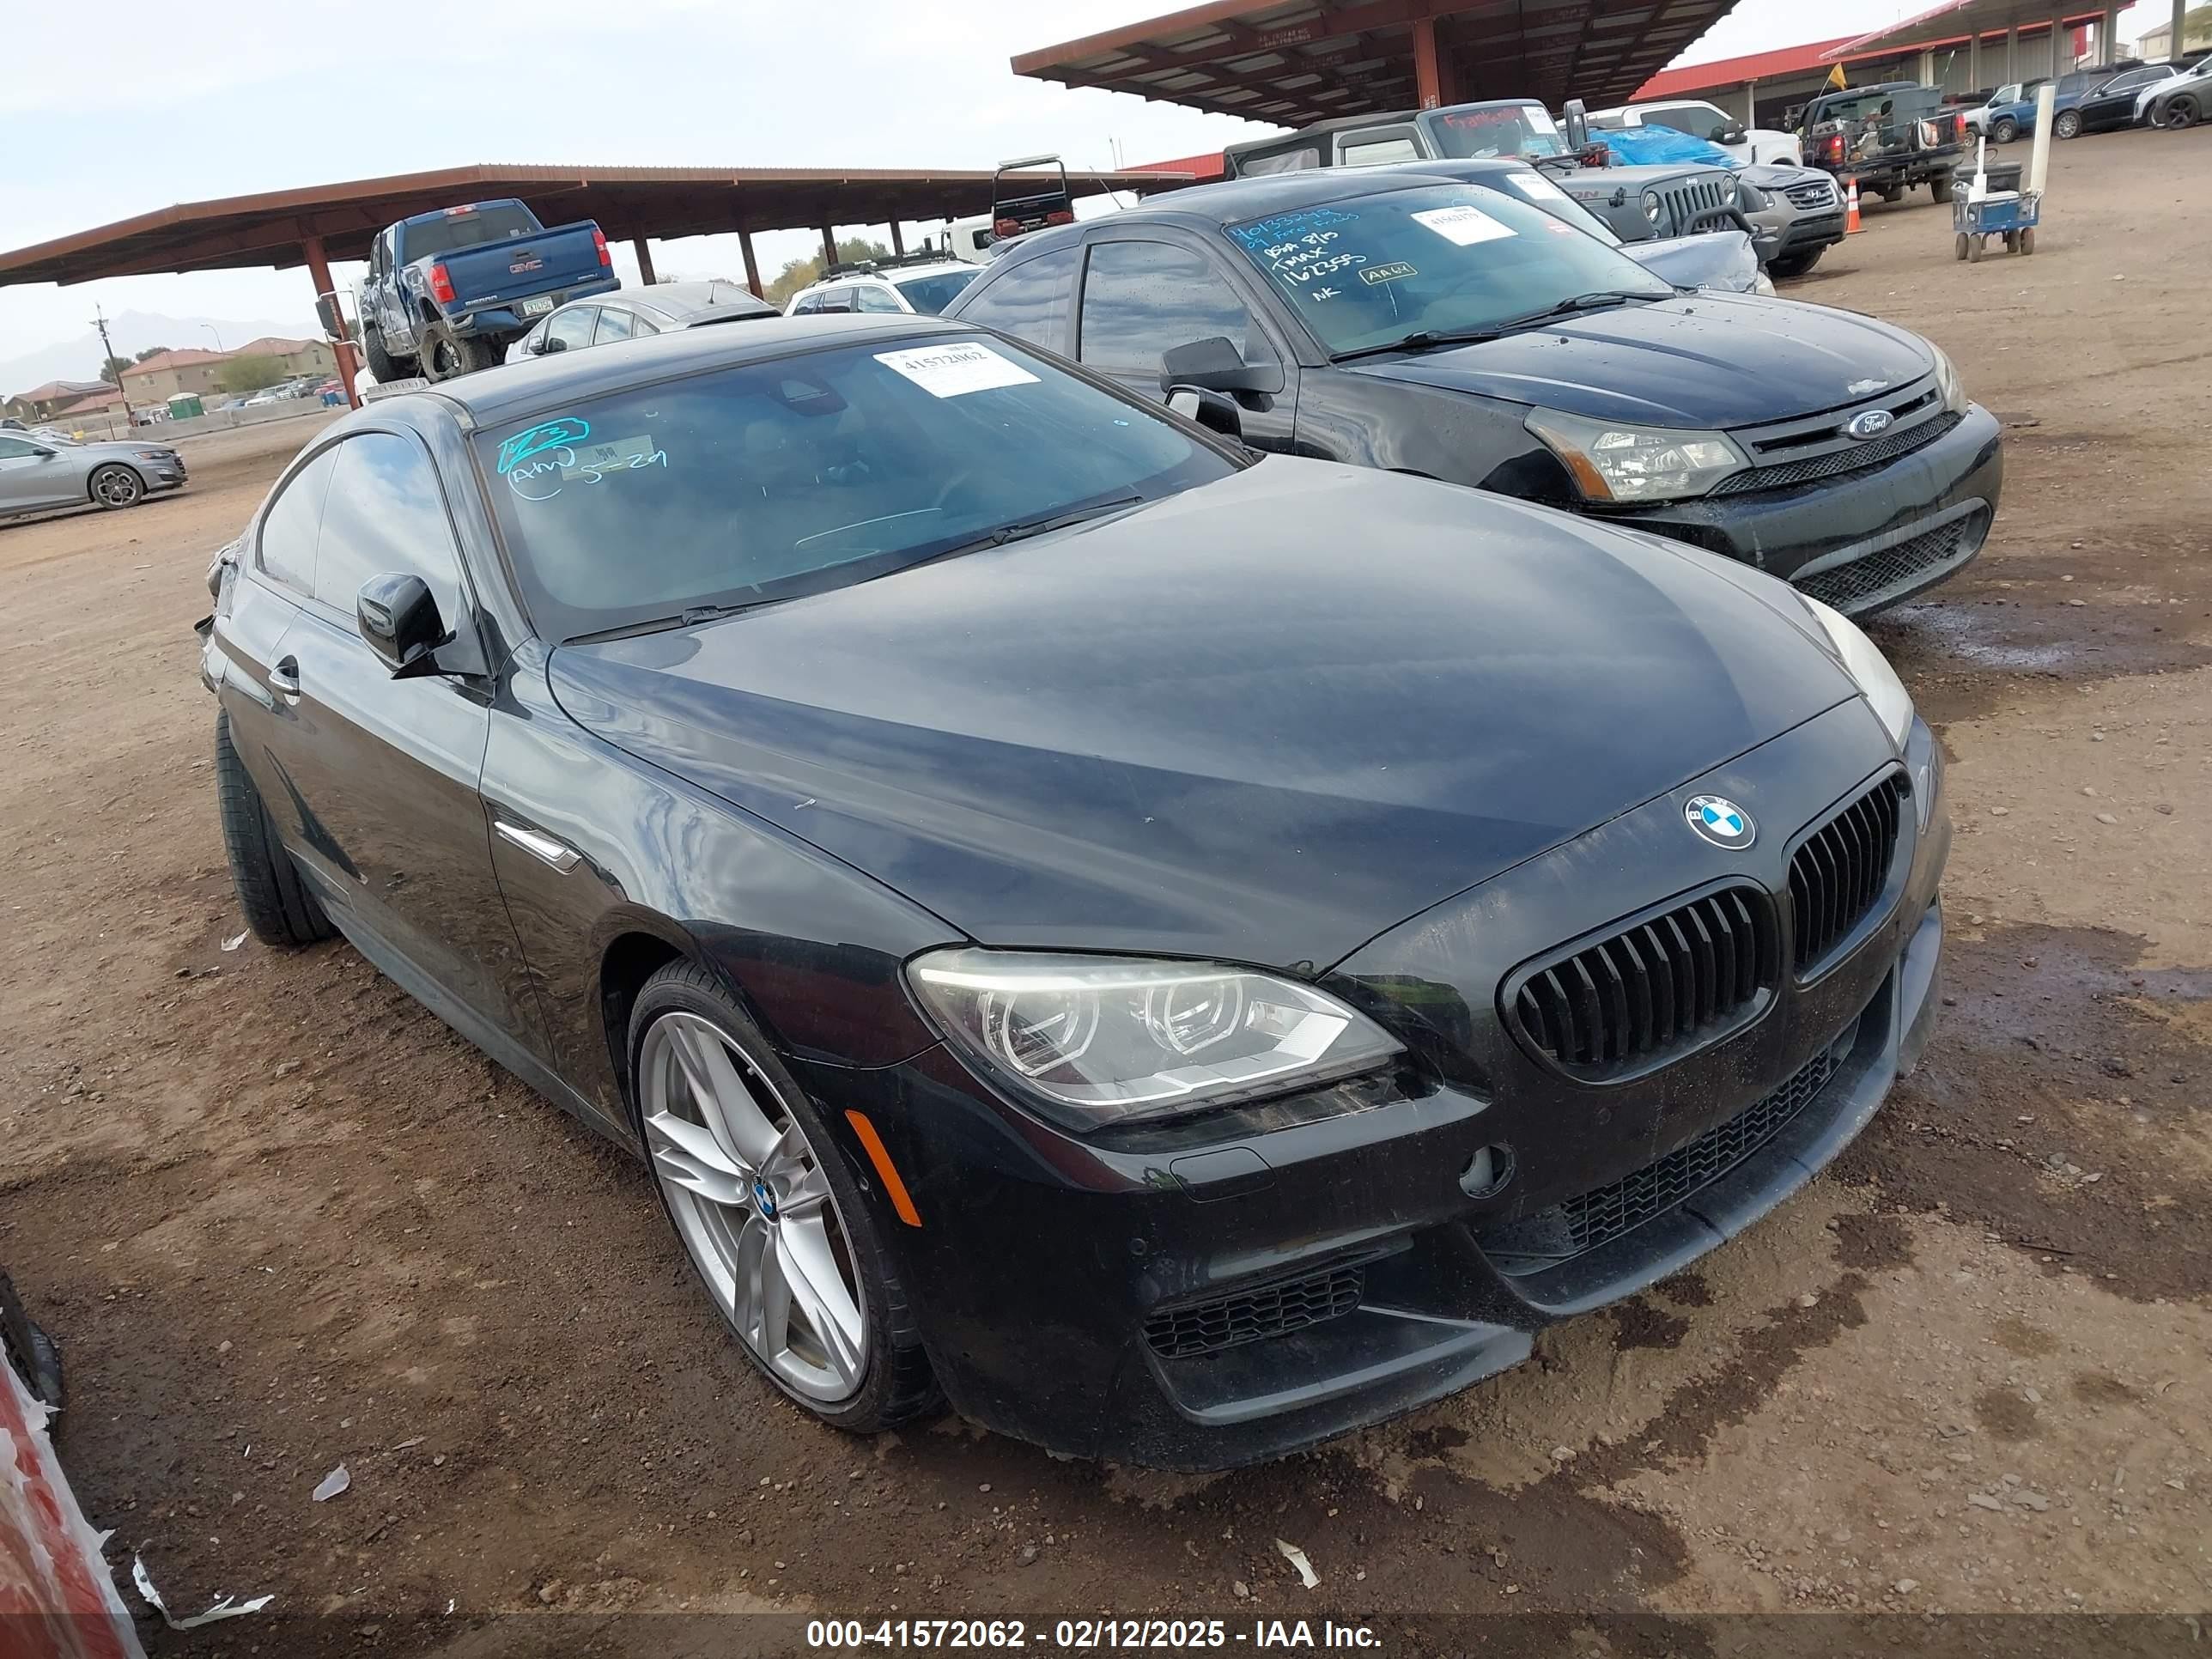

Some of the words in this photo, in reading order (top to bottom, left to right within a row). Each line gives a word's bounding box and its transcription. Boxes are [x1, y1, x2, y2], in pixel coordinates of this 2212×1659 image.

[509, 259, 544, 274] GMC
[1272, 246, 1328, 271] TMAX
[905, 351, 988, 369] 41572062
[1864, 414, 1888, 433] Ford
